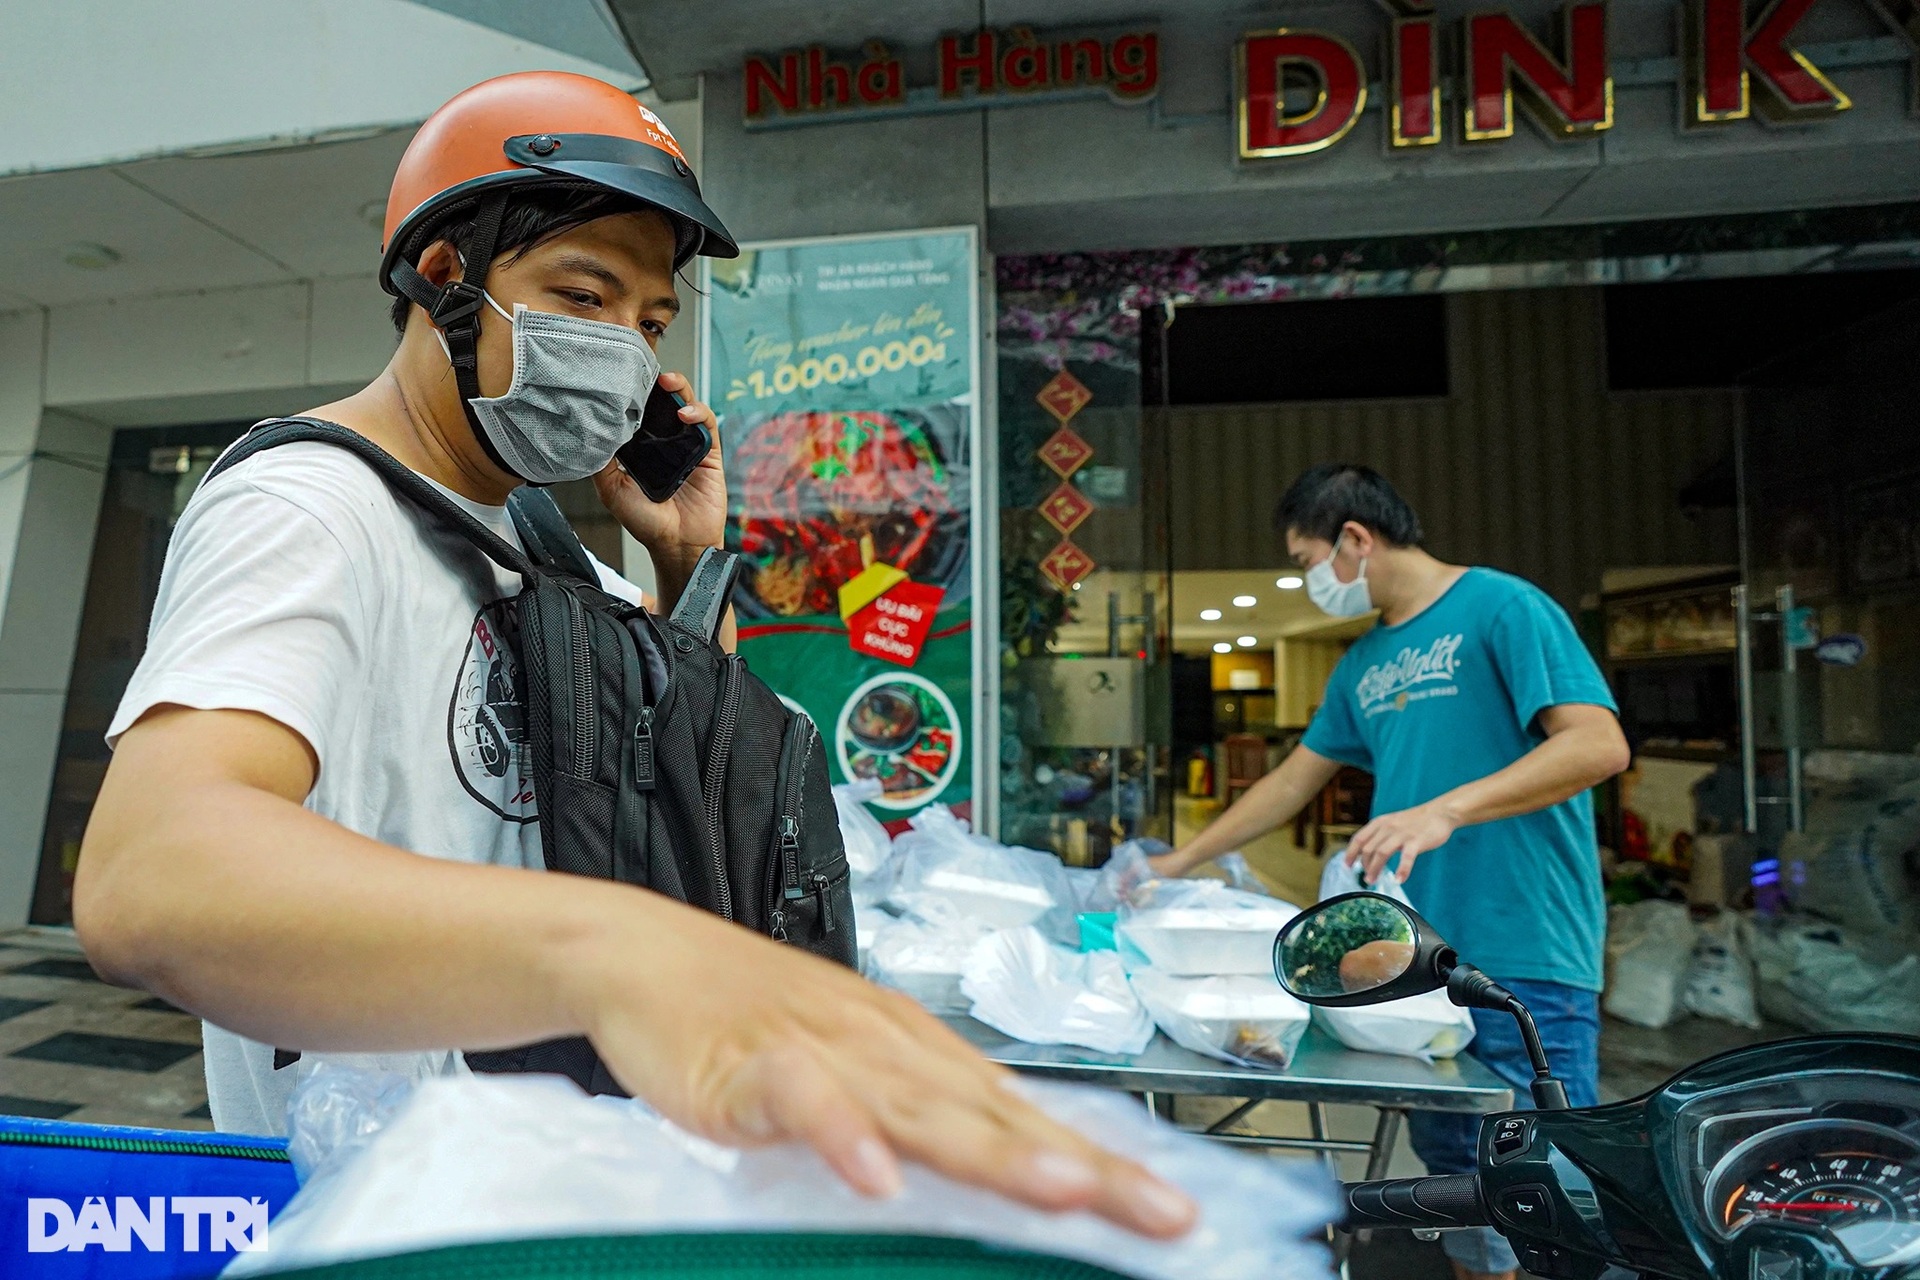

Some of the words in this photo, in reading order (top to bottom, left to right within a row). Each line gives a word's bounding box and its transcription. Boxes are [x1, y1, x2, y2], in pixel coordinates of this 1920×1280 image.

[745, 40, 901, 116] Nhà
[940, 27, 1159, 97] Hàng
[1829, 1159, 1848, 1170] 60
[1779, 1168, 1798, 1180] 40
[1745, 1190, 1764, 1203] 20
